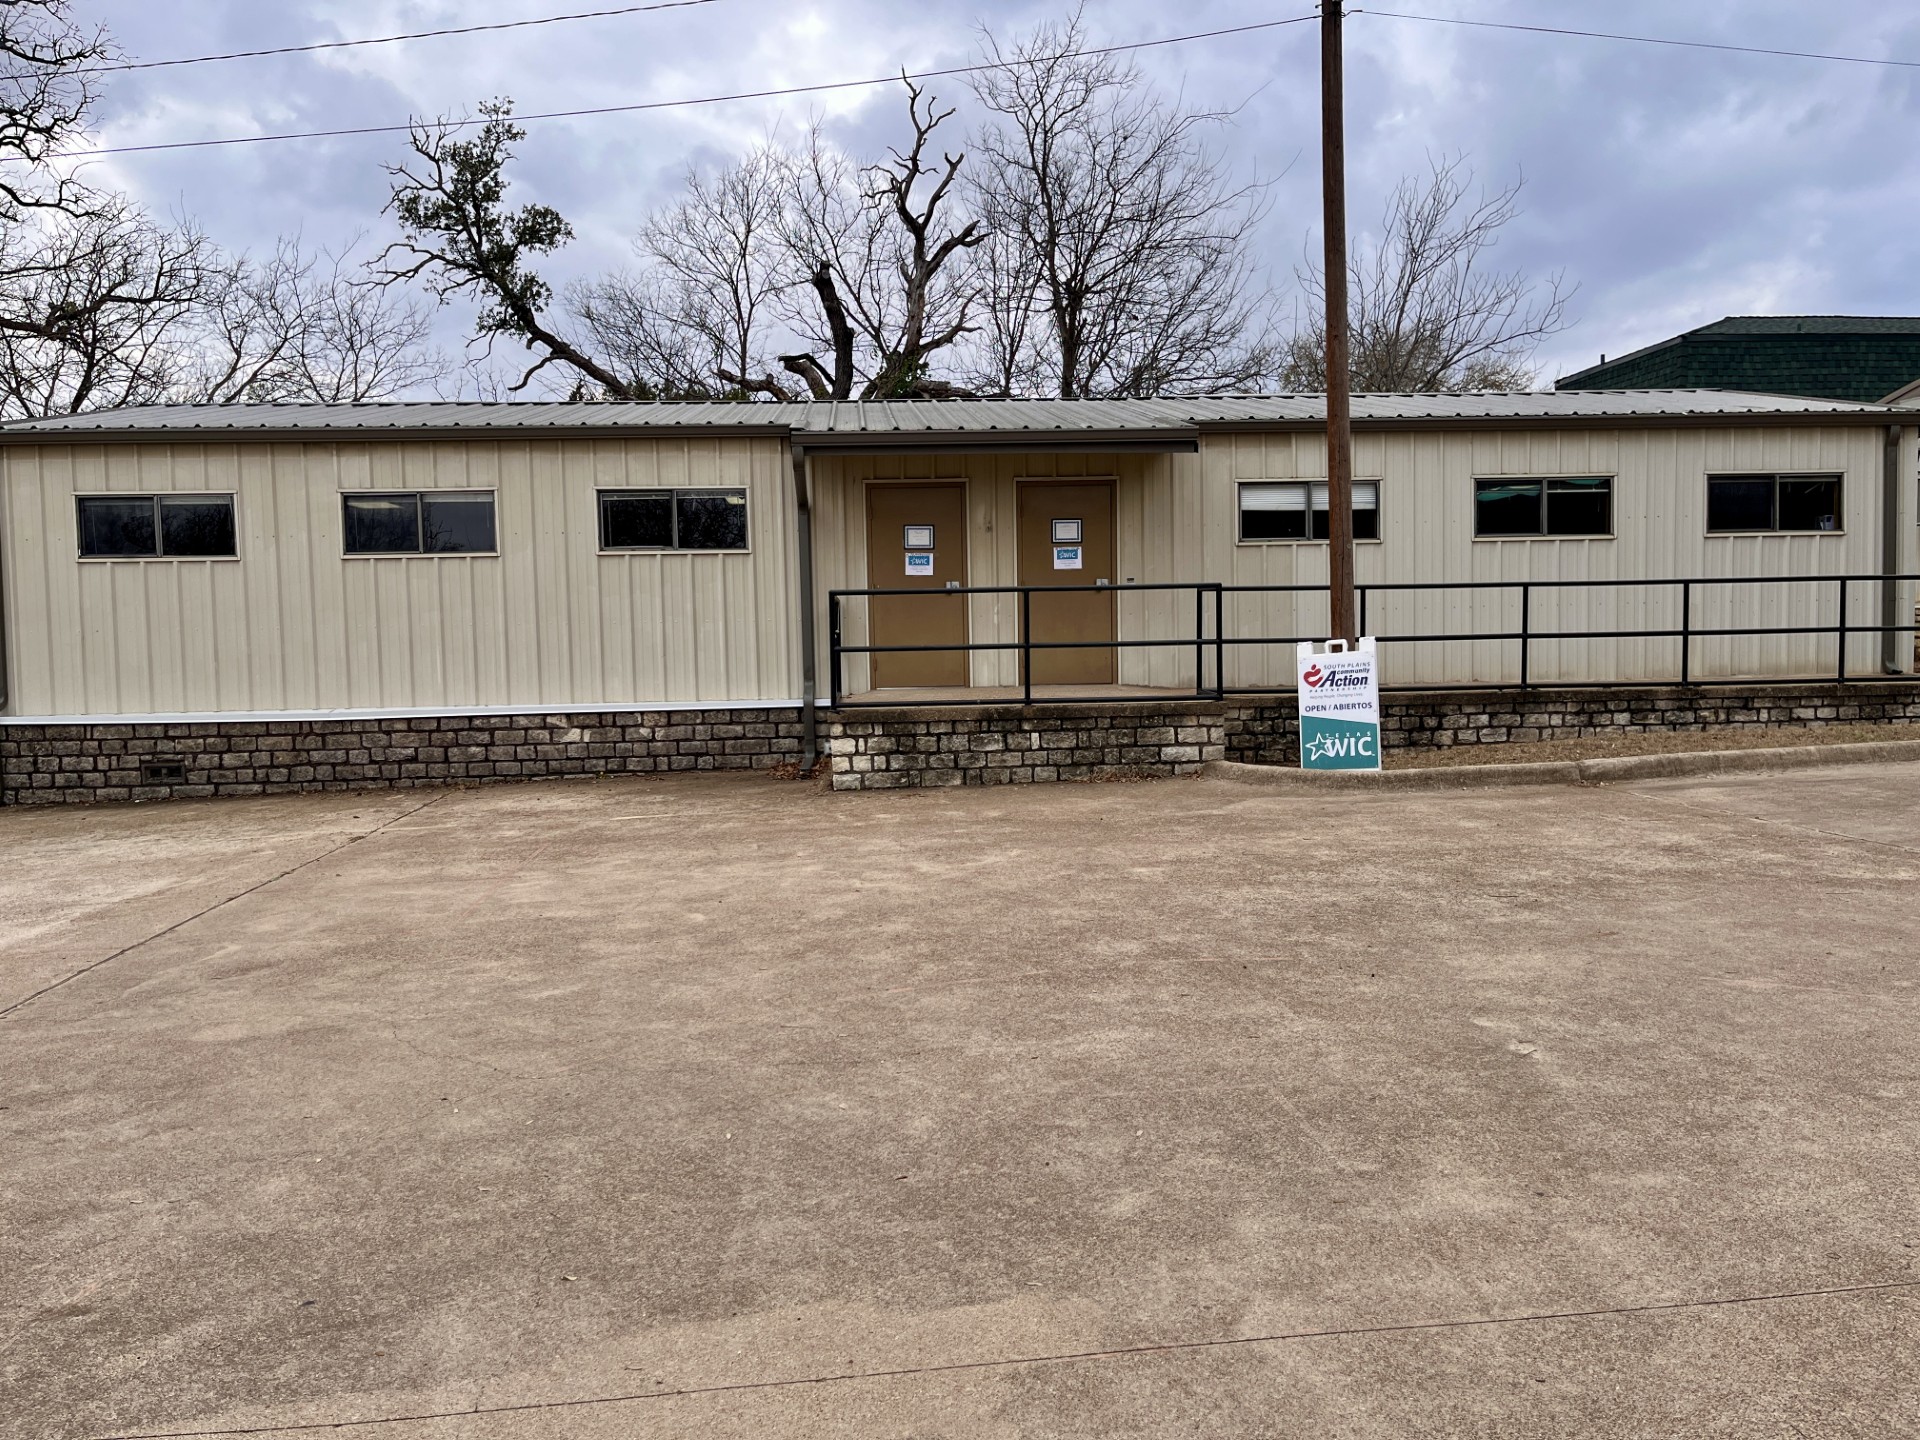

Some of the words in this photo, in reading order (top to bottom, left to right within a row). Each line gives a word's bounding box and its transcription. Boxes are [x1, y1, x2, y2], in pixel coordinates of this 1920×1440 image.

[1336, 667, 1370, 675] community
[1318, 670, 1368, 688] Action
[1304, 704, 1327, 712] OPEN
[1333, 702, 1373, 711] ABIERTOS
[1326, 736, 1372, 757] WIC
